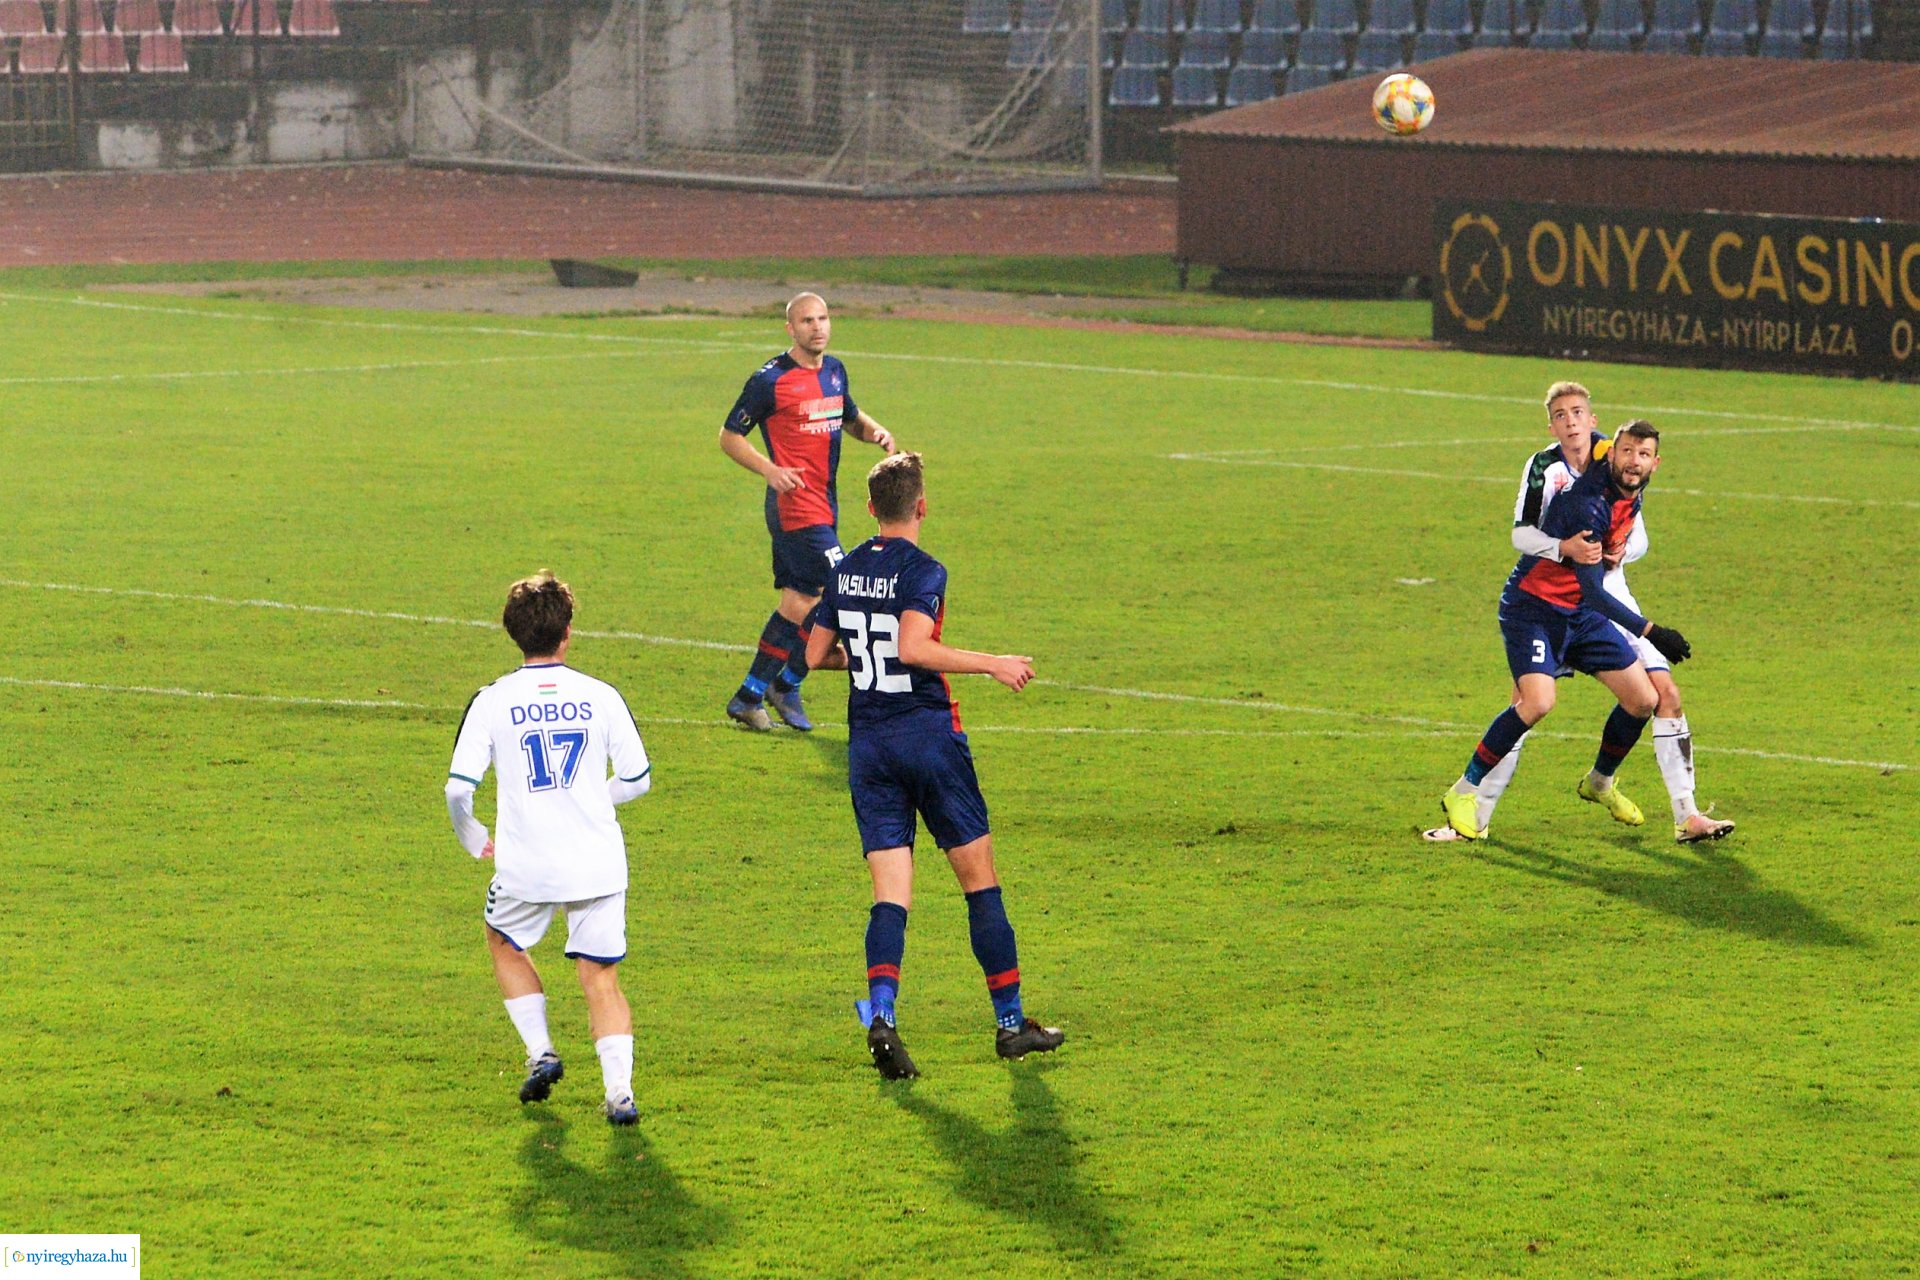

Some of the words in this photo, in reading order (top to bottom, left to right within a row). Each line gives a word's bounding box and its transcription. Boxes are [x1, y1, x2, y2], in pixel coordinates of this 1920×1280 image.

[1527, 219, 1693, 295] ONYX
[838, 609, 913, 693] 32
[1531, 640, 1546, 663] 3
[510, 702, 592, 725] DOBOS
[520, 728, 588, 792] 17
